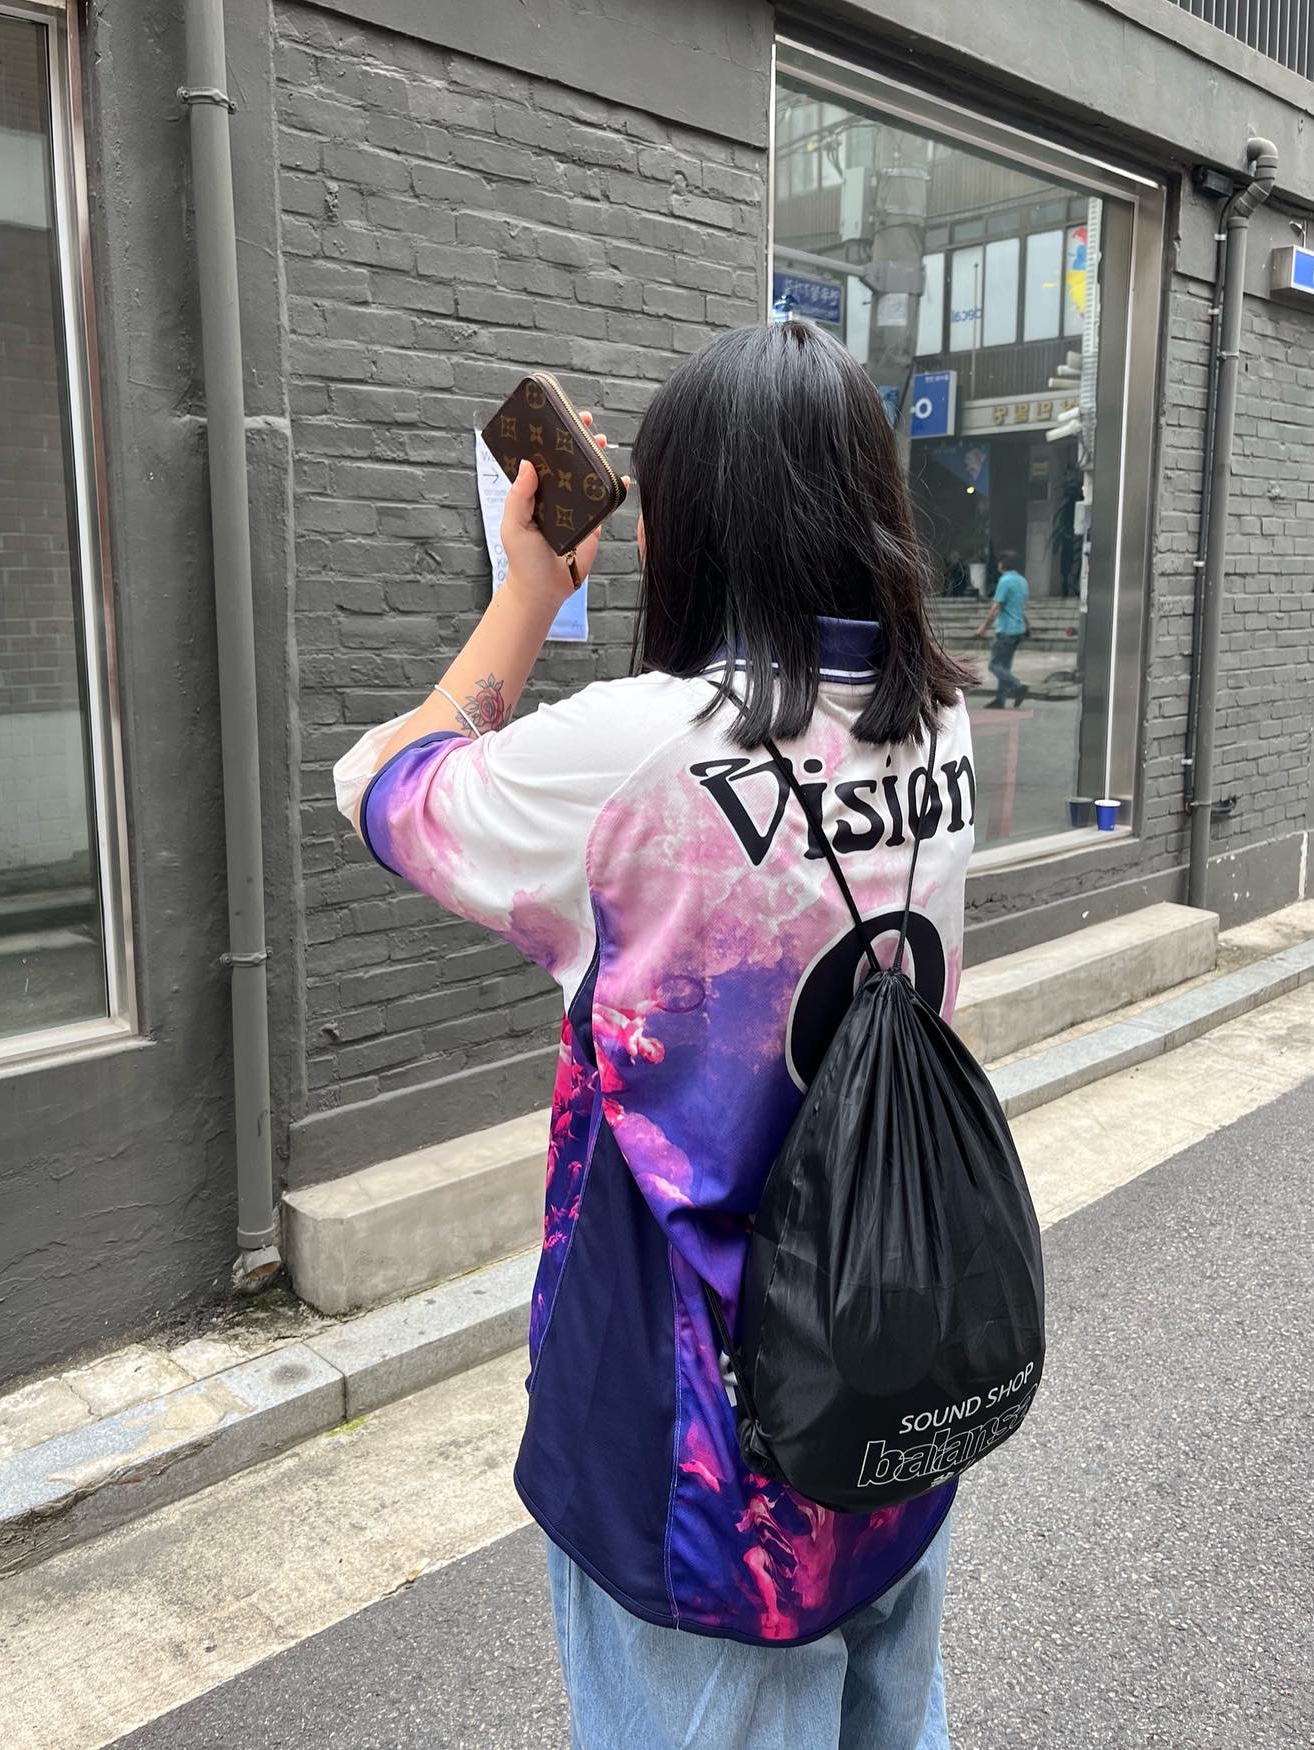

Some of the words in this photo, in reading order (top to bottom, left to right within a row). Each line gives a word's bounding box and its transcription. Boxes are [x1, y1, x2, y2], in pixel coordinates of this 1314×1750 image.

[689, 755, 977, 866] Vision
[899, 1396, 981, 1435] SOUND
[985, 1361, 1034, 1409] SHOP
